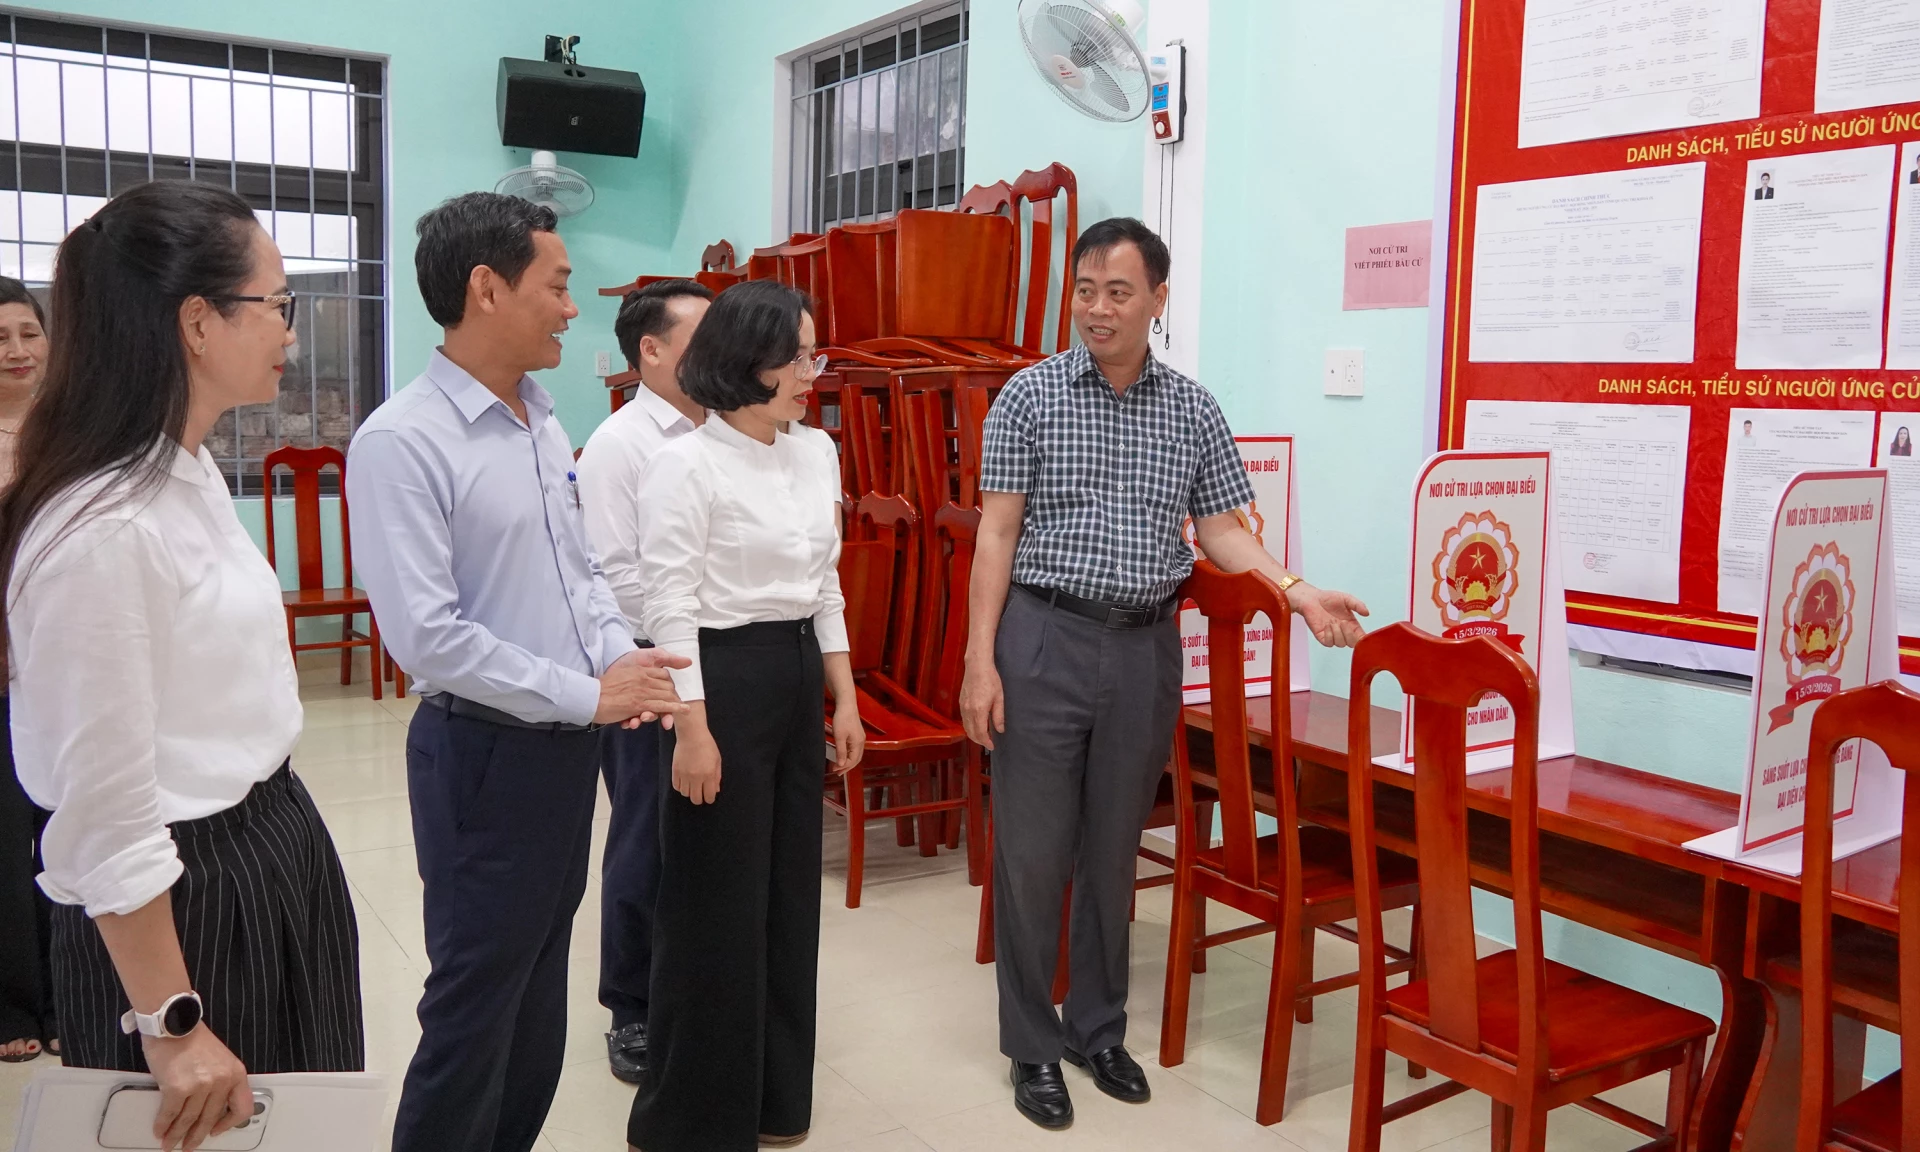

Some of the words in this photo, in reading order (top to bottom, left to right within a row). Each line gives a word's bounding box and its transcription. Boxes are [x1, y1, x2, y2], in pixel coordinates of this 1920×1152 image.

[1626, 143, 1672, 163] DANH
[1676, 136, 1729, 158] SÁCH,
[1735, 123, 1775, 151] TIỂU
[1780, 120, 1808, 146] SỬ
[1811, 114, 1875, 142] NGƯỜI
[1396, 245, 1408, 253] TRI
[1598, 378, 1642, 394] DANH
[1646, 375, 1697, 397] SÁCH,
[1702, 371, 1741, 396] TIỂU
[1745, 374, 1772, 396] SỬ
[1775, 376, 1836, 397] NGƯỜI
[1841, 376, 1885, 398] ỨNG
[1250, 460, 1262, 475] ĐẠI
[1429, 481, 1443, 498] NƠI
[1444, 477, 1456, 497] CỬ
[1457, 482, 1468, 497] TRI
[1469, 480, 1483, 499] LỰA
[1485, 480, 1505, 499] CHỌN
[1506, 480, 1518, 498] ĐẠI
[1519, 474, 1536, 494] BIỂU
[1809, 507, 1819, 525] TRI
[1453, 626, 1498, 640] 15/3/2026
[1191, 655, 1201, 670] ĐẠI
[1795, 682, 1832, 701] 15/3/2026
[1467, 711, 1479, 726] CHO
